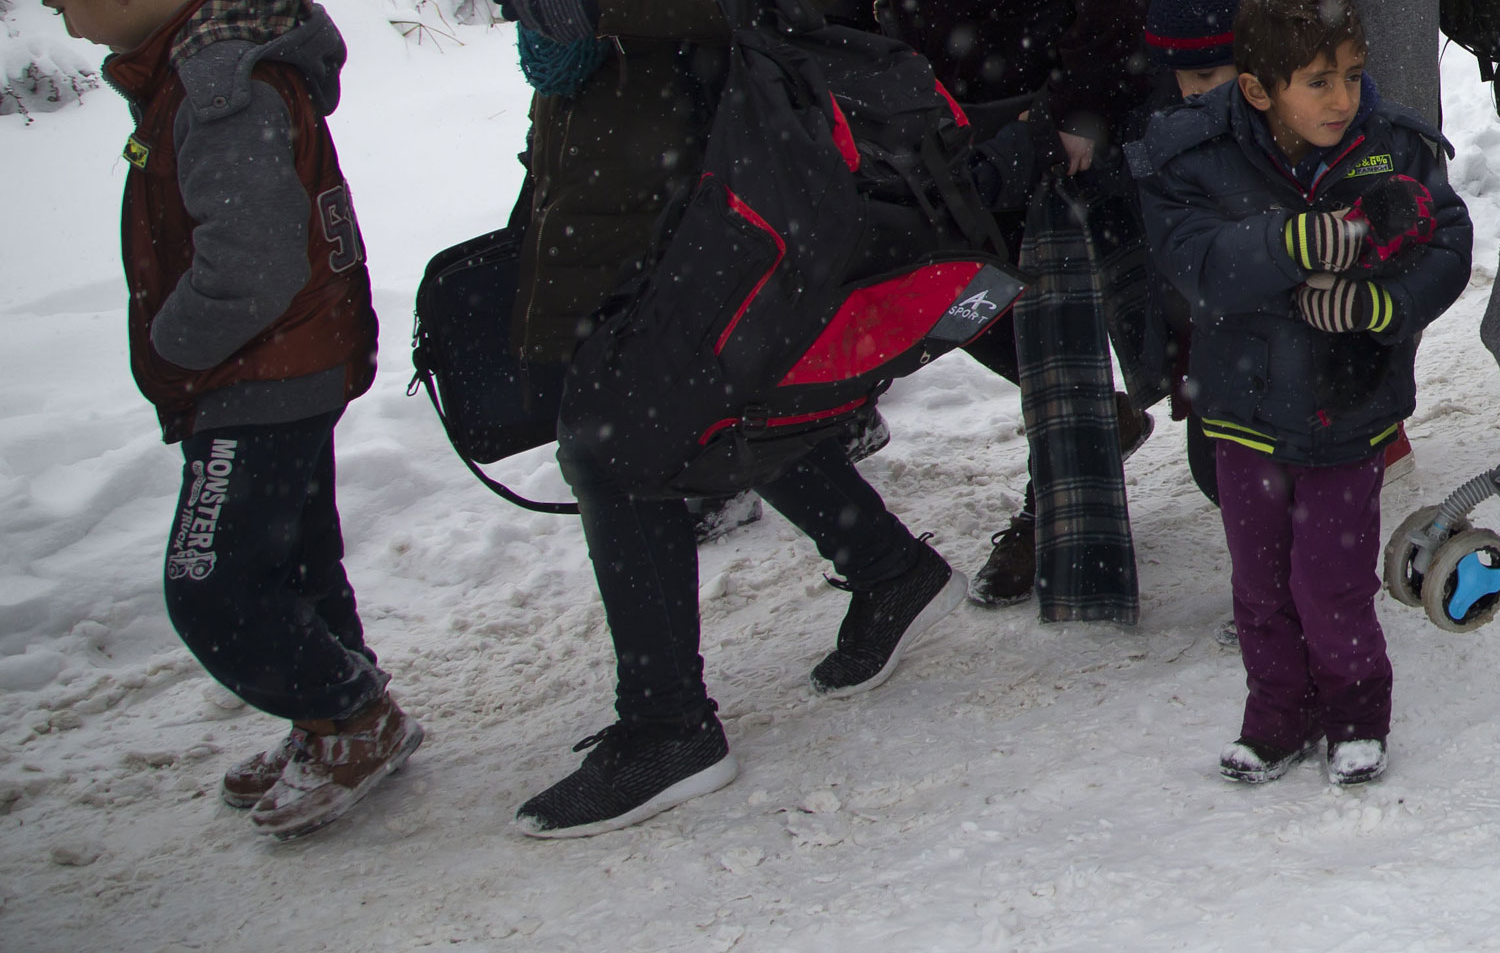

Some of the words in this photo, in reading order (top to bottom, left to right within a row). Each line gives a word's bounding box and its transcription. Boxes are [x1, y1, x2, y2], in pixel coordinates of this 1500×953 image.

[948, 305, 989, 324] SPORT
[187, 438, 238, 548] MONSTER
[173, 507, 195, 551] TRUCK
